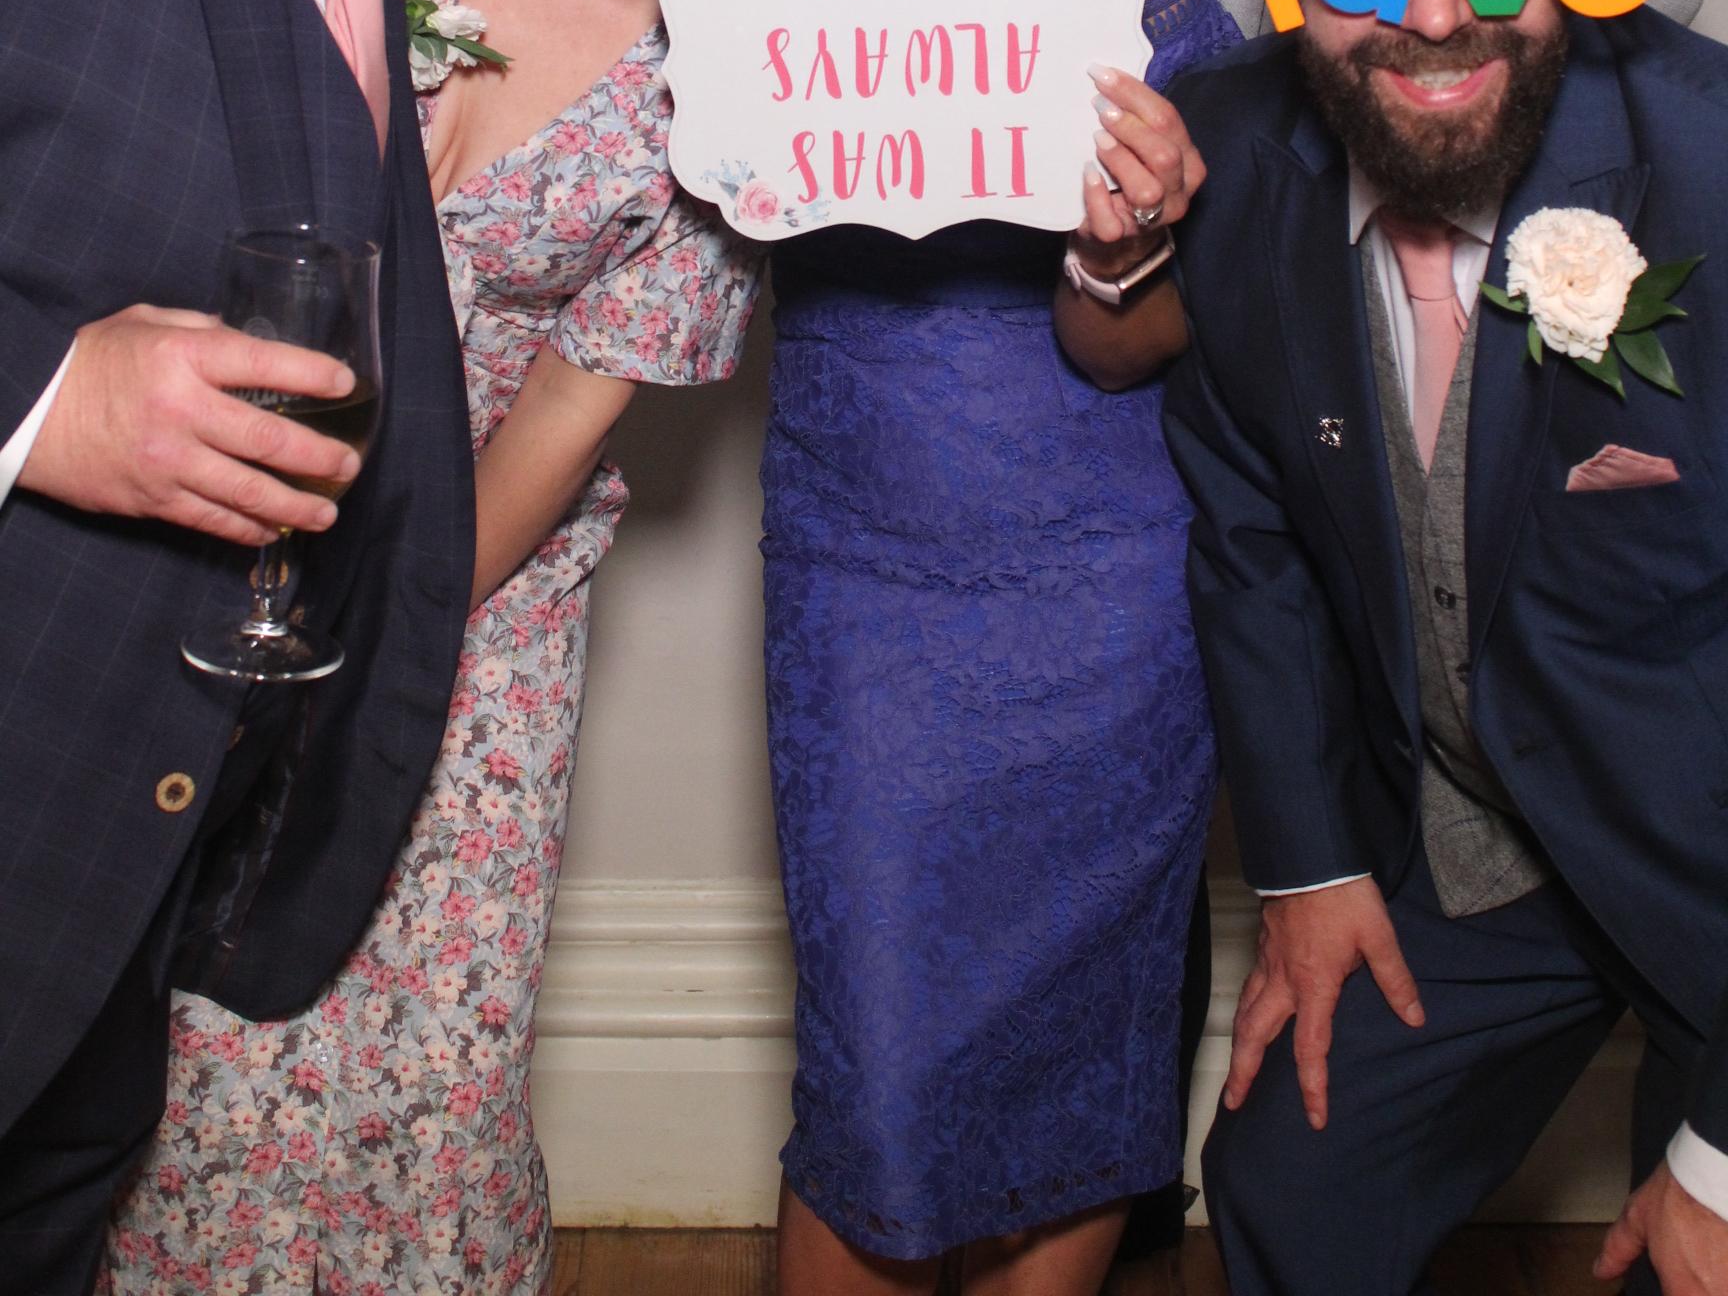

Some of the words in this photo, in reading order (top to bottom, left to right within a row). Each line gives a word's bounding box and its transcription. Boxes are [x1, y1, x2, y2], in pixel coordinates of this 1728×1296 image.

[762, 23, 1041, 102] ALWAYS
[788, 129, 925, 205] WAS
[960, 126, 1035, 199] IT
